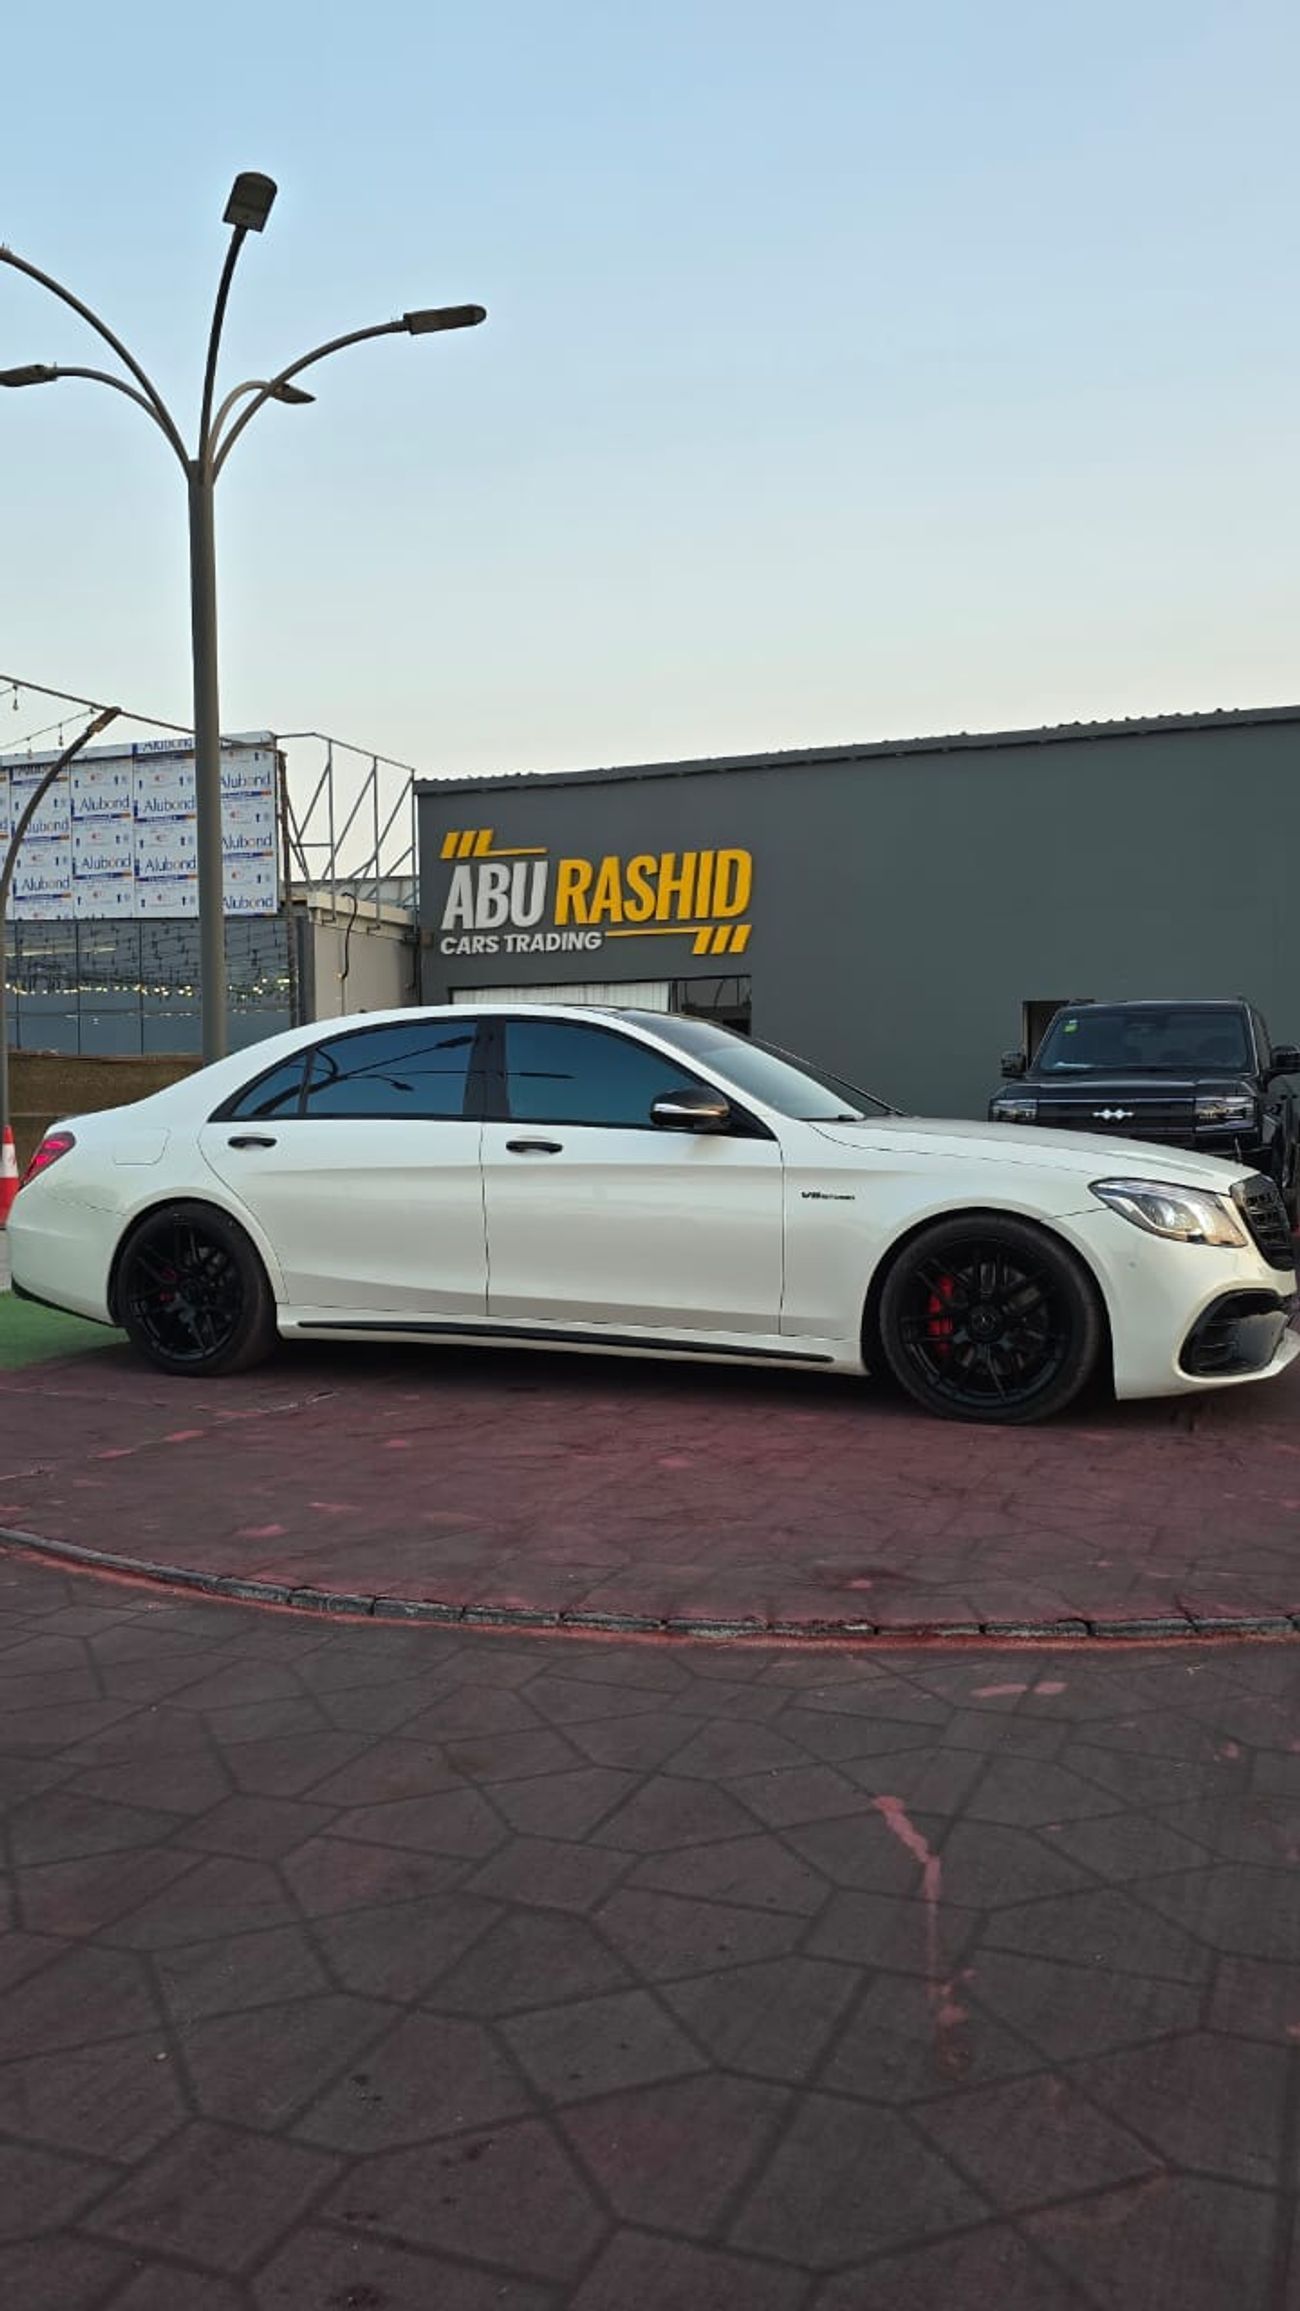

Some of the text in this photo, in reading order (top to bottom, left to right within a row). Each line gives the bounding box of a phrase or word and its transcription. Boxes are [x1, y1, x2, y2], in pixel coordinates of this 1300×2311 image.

[80, 795, 130, 811] Alubond
[143, 795, 195, 812] Alubond
[26, 817, 69, 834] lubond
[81, 852, 131, 870] Alubond
[145, 854, 196, 872] Alubond
[22, 876, 70, 892] Alubond
[441, 849, 753, 931] ABU RASHID
[440, 931, 603, 955] CARS TRADING
